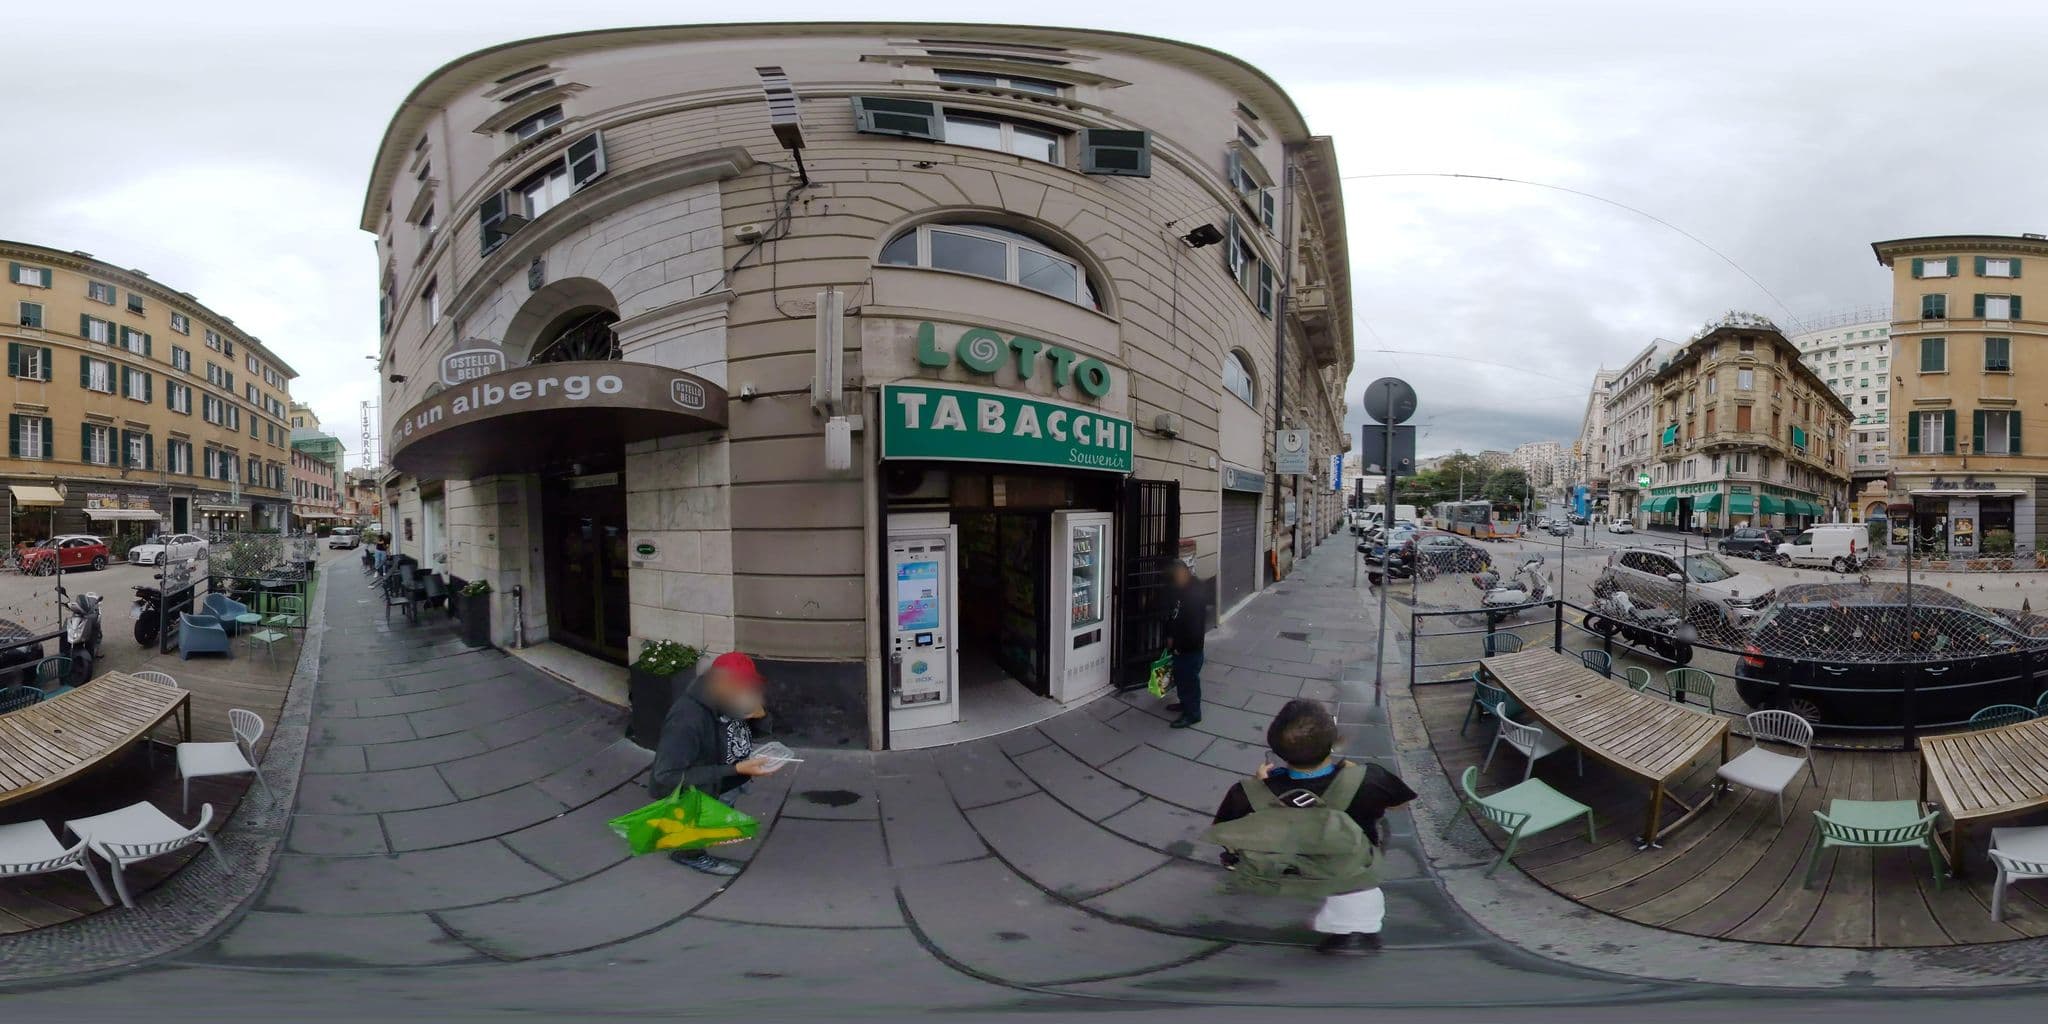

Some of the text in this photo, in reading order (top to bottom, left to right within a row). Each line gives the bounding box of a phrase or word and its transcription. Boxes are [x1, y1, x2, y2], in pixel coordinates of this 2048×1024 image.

[450, 354, 497, 369] OSTELLO
[917, 321, 1111, 397] LOTTO
[457, 366, 490, 381] BELLO
[676, 381, 702, 397] OSTELLO
[416, 405, 443, 429] un
[452, 375, 624, 415] albergo
[680, 392, 699, 405] BELLO
[897, 392, 1127, 451] TABACCHI
[1069, 448, 1124, 468] Souvenir
